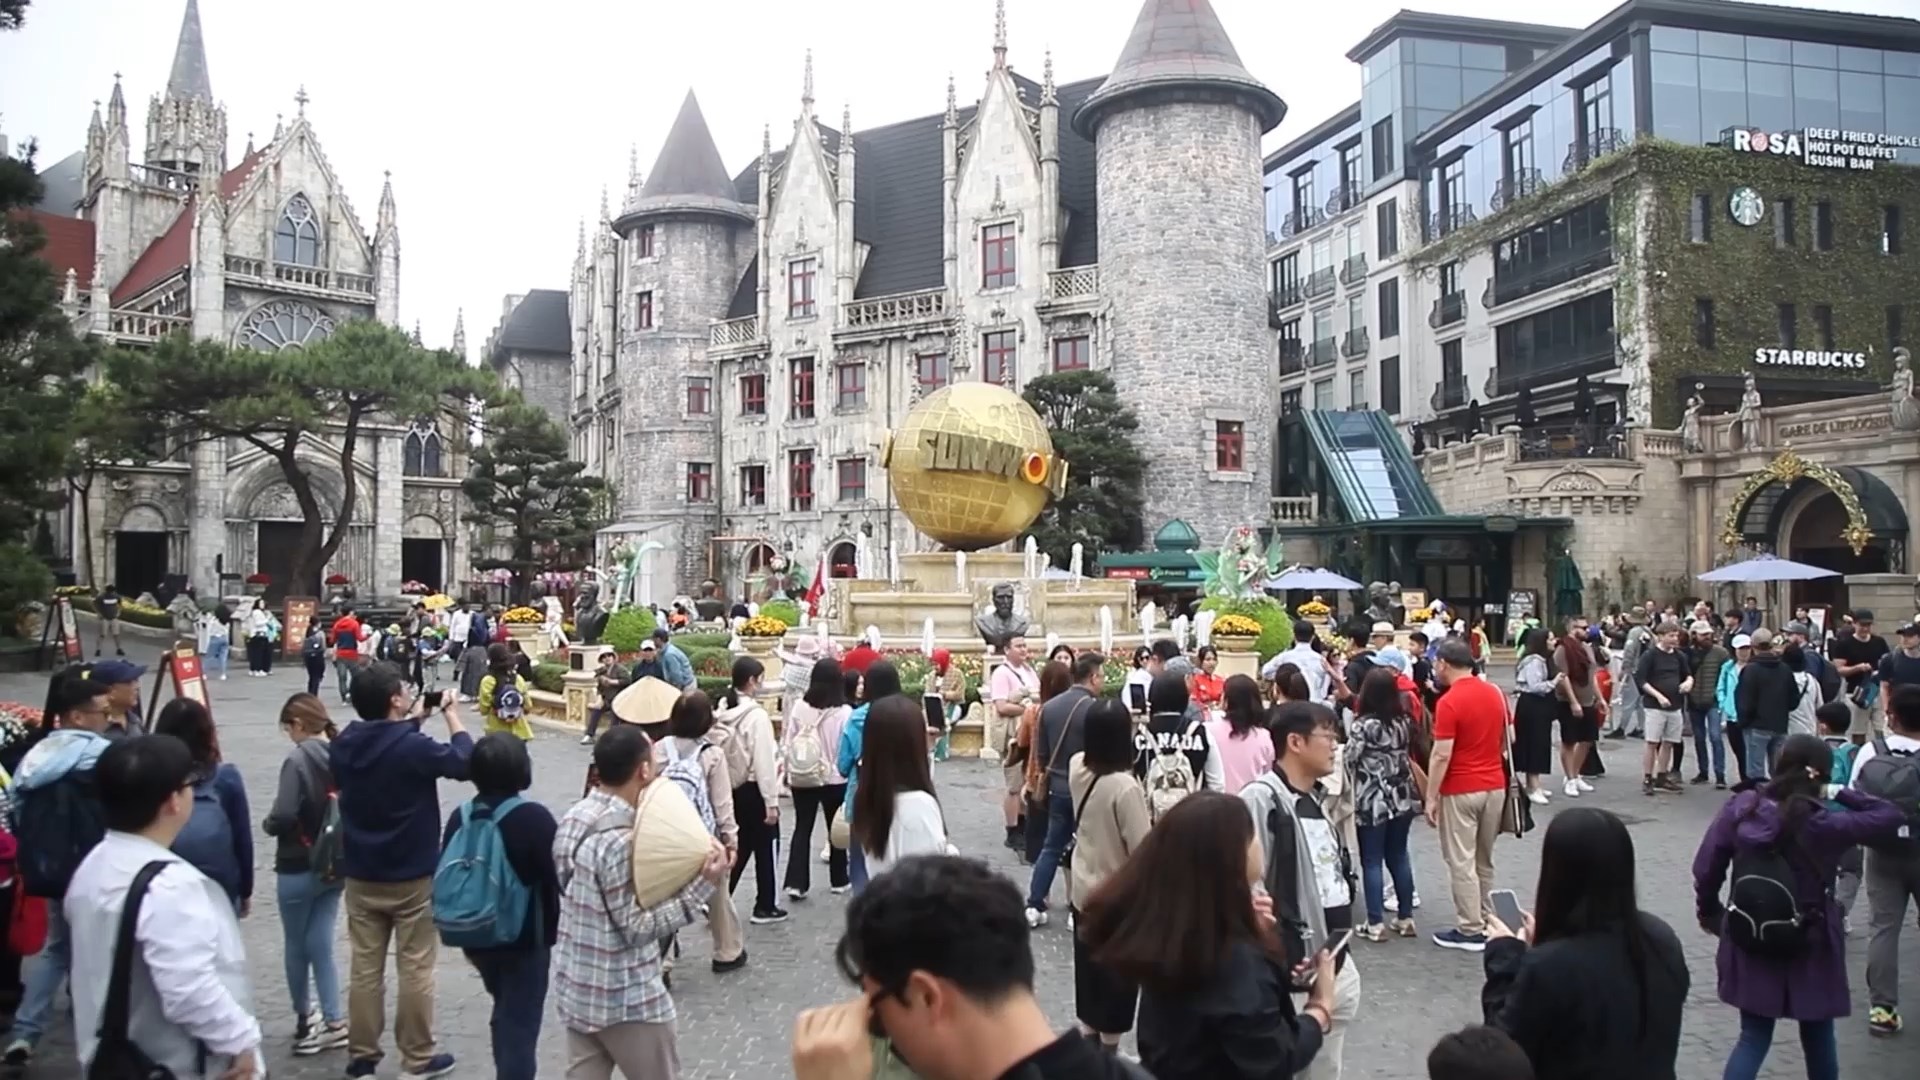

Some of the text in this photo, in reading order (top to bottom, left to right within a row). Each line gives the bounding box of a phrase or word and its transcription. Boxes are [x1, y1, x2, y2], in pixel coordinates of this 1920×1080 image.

[1734, 129, 1801, 156] ROSA
[1809, 127, 1920, 147] DEEP FRIED CHICKE
[1809, 141, 1897, 159] HOT POT BUFFET
[1810, 155, 1874, 170] SUSHI BAR
[1756, 349, 1865, 368] STARBUCKS
[1779, 424, 1811, 438] GARE
[1812, 421, 1828, 434] DE
[919, 429, 989, 471] SUN
